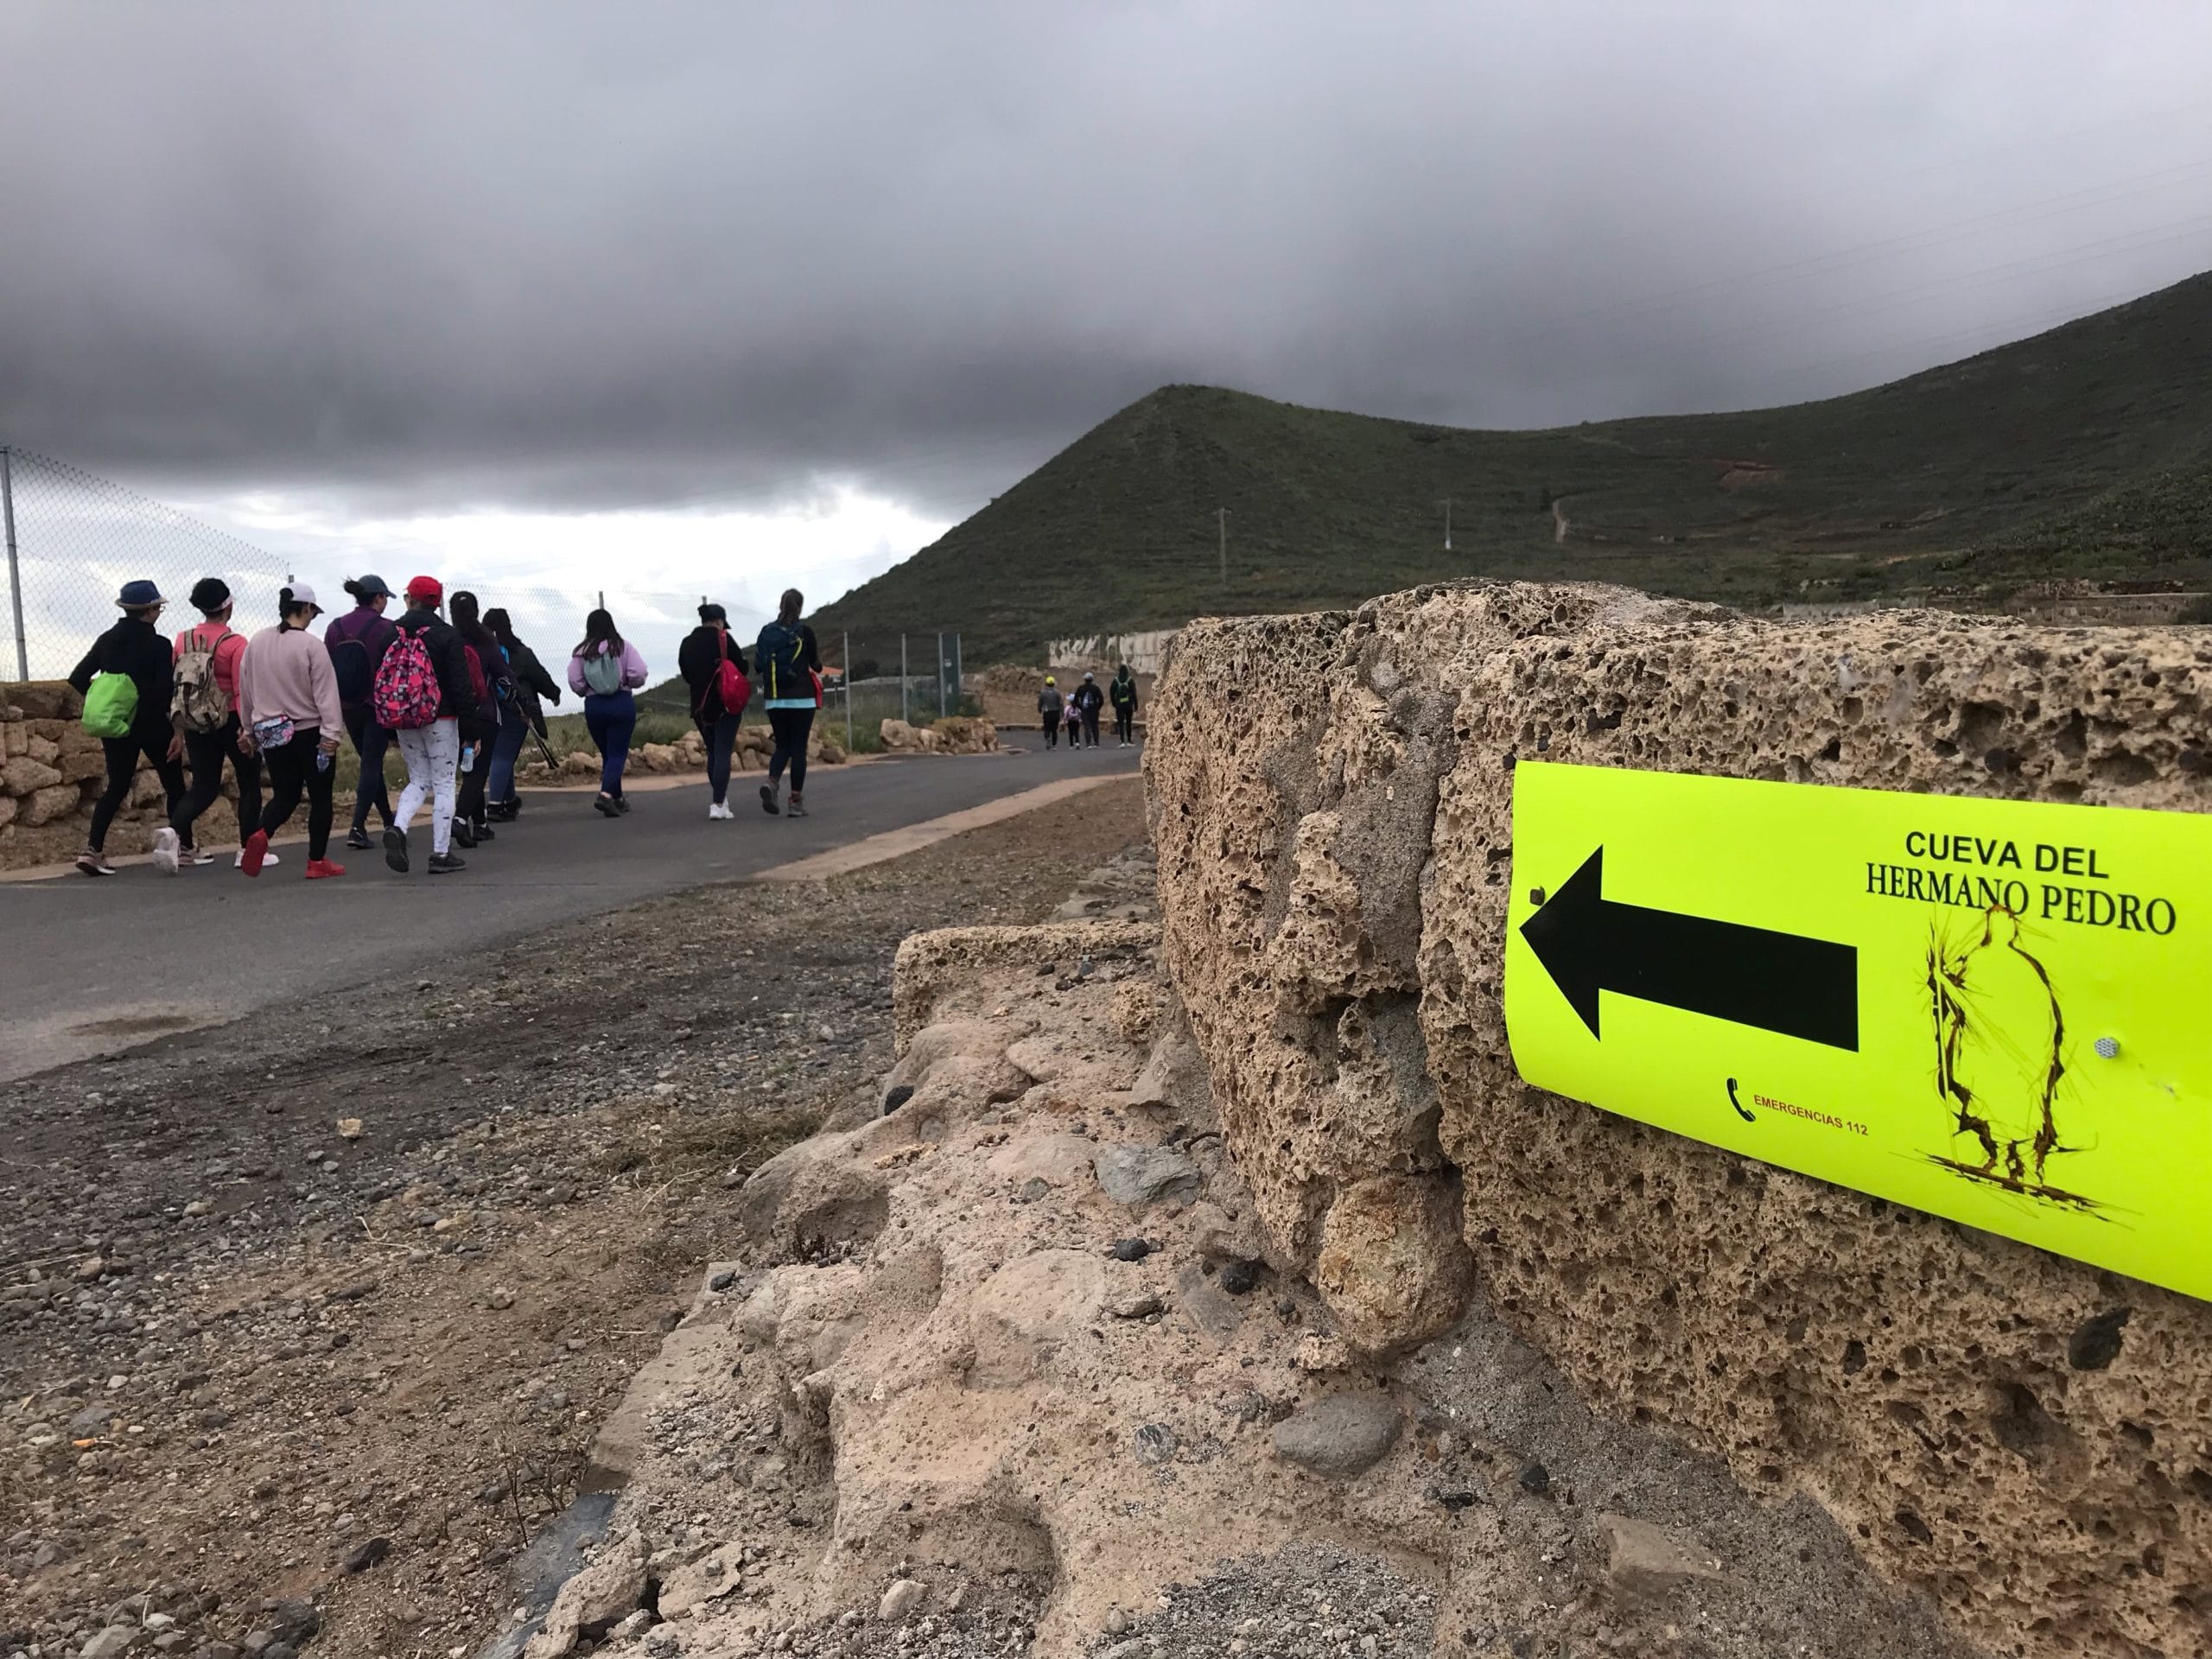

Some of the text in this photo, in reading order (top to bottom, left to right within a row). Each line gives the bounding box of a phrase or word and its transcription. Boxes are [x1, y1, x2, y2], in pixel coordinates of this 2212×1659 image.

[1906, 831, 2109, 879] CUEVA DEL
[1866, 862, 2177, 935] HERMANO PEDRO
[1753, 1094, 1869, 1136] EMERGENCIAS 112
